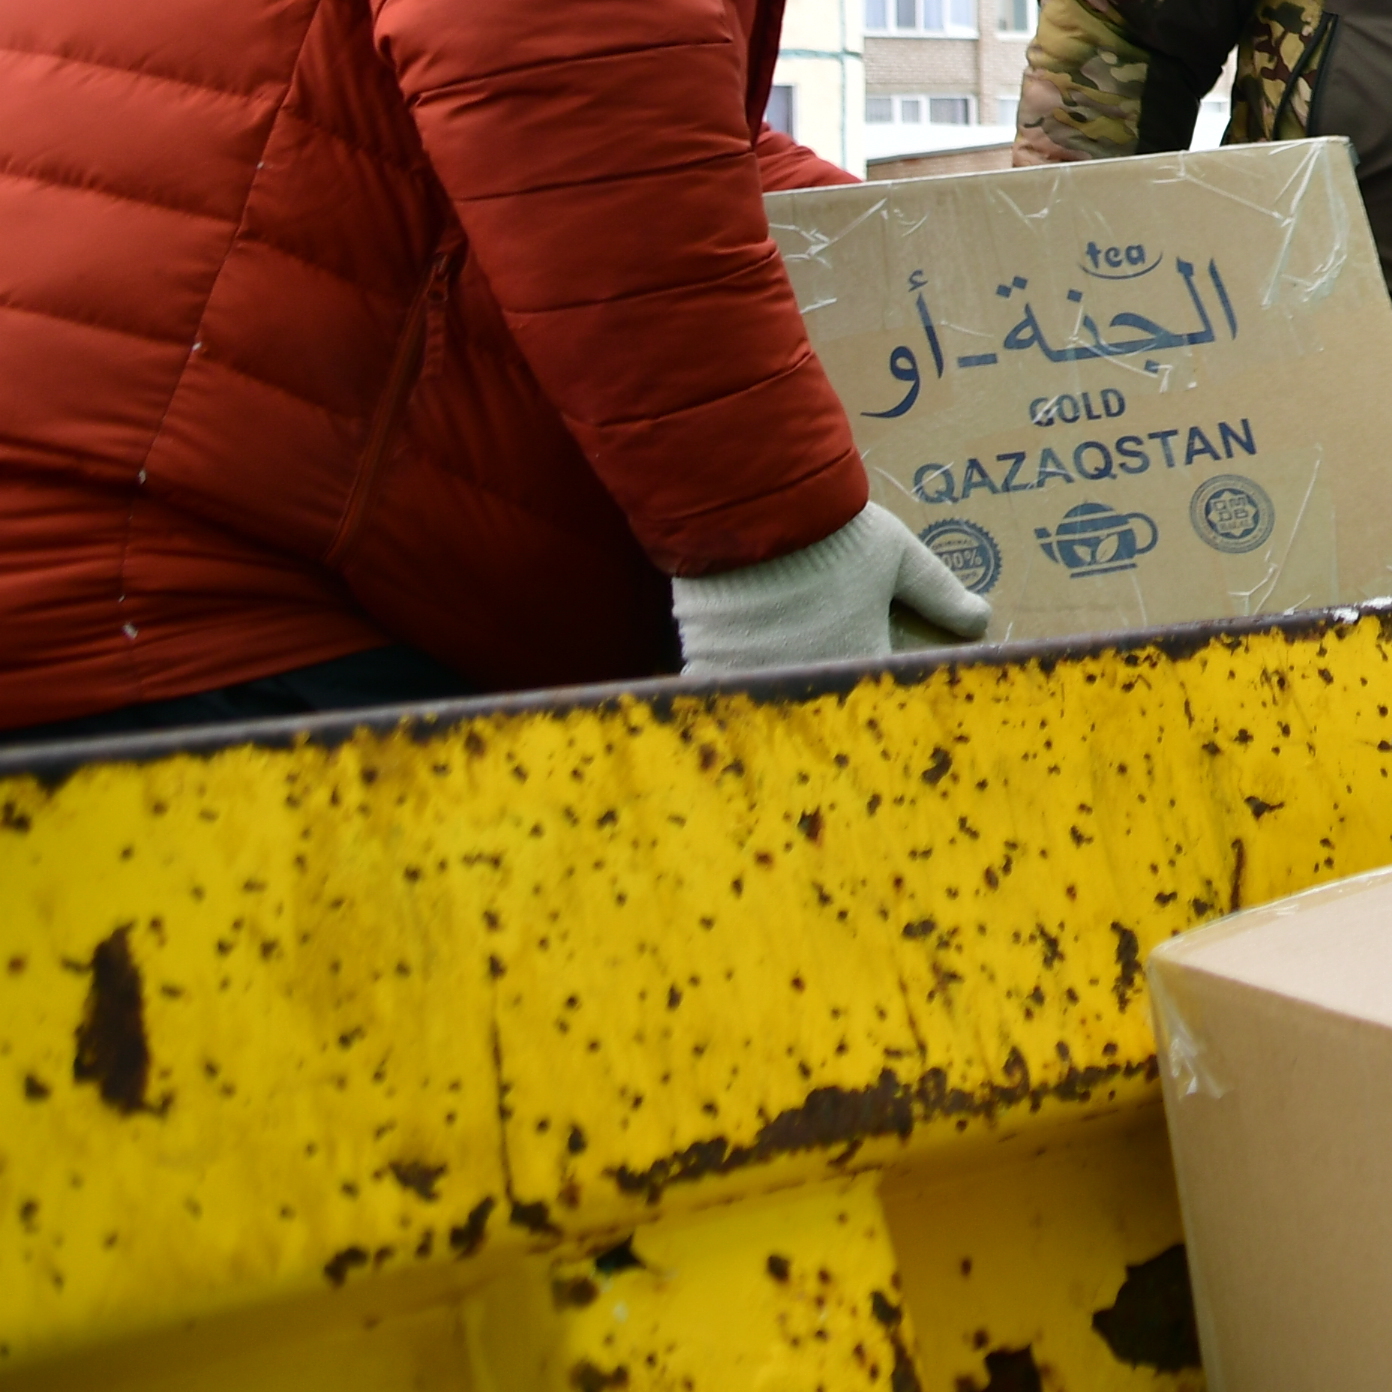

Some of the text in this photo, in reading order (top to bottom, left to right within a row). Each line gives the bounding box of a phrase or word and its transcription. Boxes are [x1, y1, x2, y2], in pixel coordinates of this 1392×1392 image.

[1086, 242, 1145, 268] tea
[1029, 388, 1126, 427] GOLD
[911, 418, 1257, 505] QAZAQSTAN
[938, 548, 982, 568] 00%
